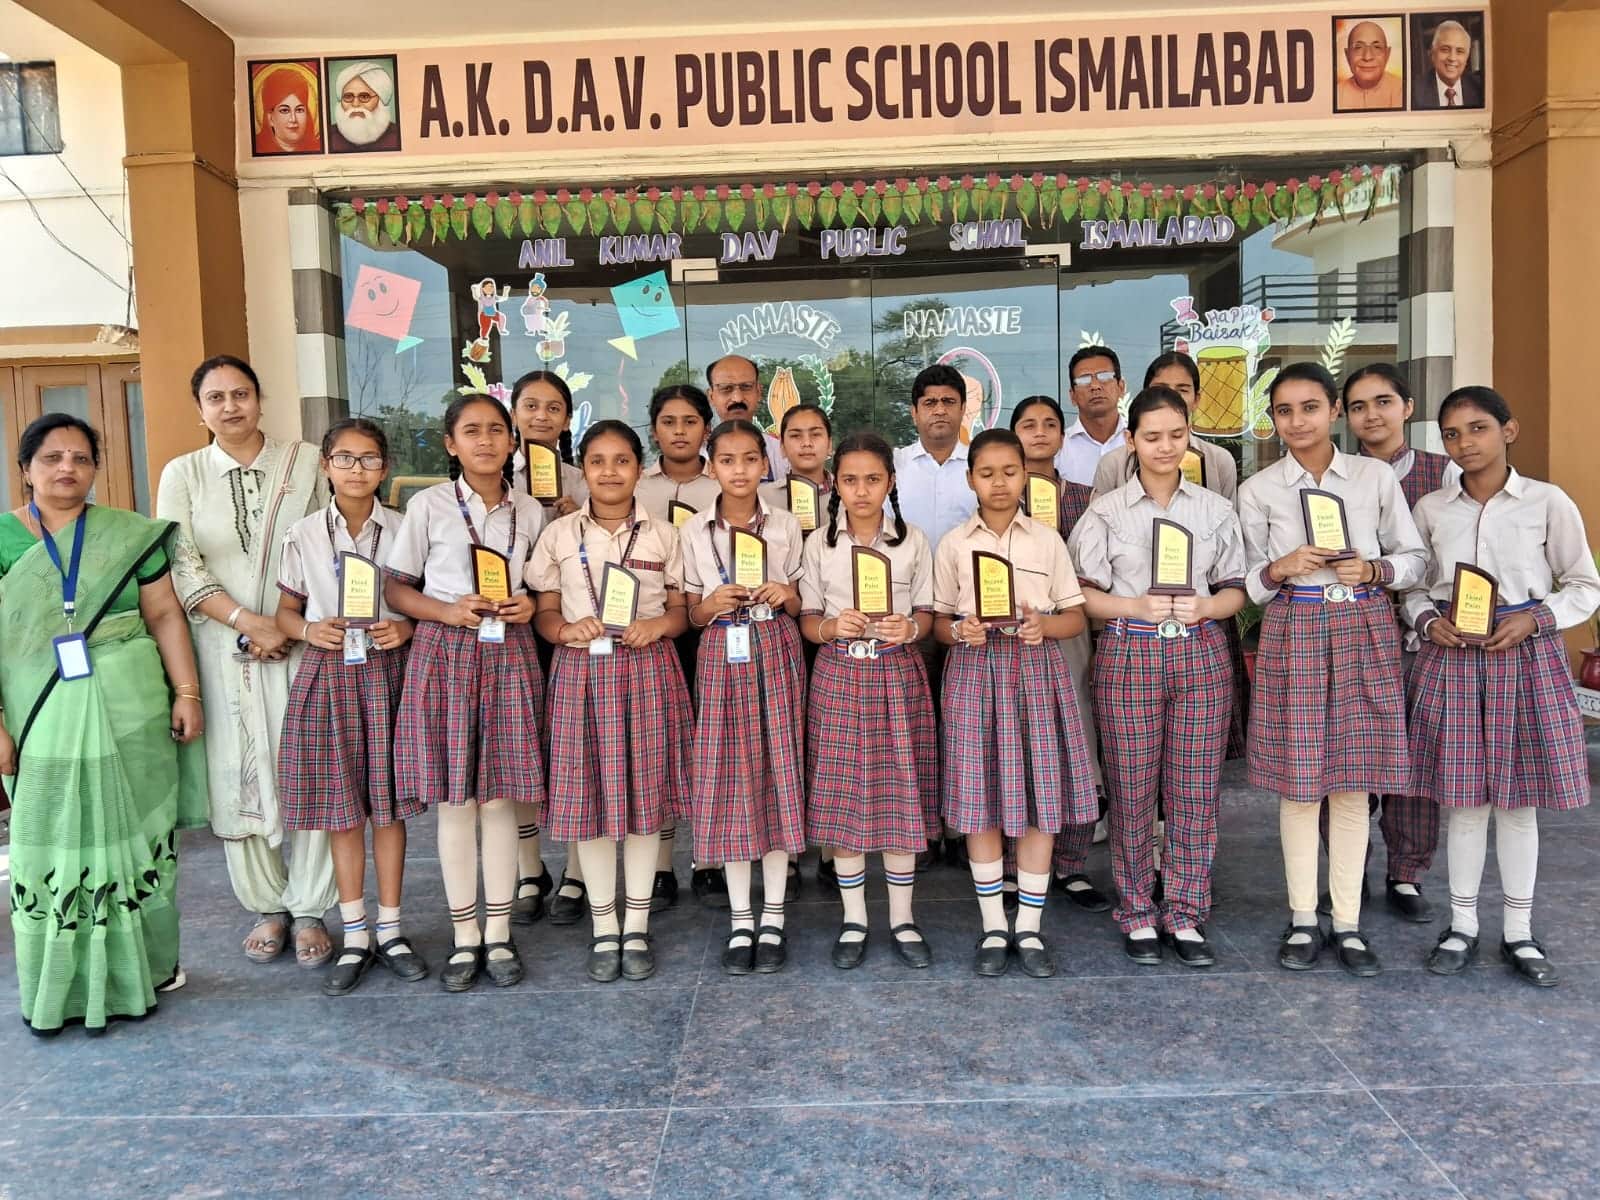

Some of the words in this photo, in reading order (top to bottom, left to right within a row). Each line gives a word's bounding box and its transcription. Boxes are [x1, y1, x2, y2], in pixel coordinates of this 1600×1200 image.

[420, 63, 510, 138] A.K.
[523, 55, 662, 134] D.A.V.
[675, 47, 834, 129] PUBLIC
[845, 40, 1022, 122] SCHOOL
[1034, 29, 1315, 114] ISMAILABAD
[519, 238, 574, 268] ANIL
[599, 232, 682, 265] KUMAR
[721, 230, 779, 263] DAV
[820, 226, 907, 259] PUBLIC
[950, 219, 1027, 251] SCHOOL
[1080, 215, 1235, 249] ISMAILABAD
[719, 301, 841, 355] NAMASTE
[904, 306, 1022, 338] NAMASTE
